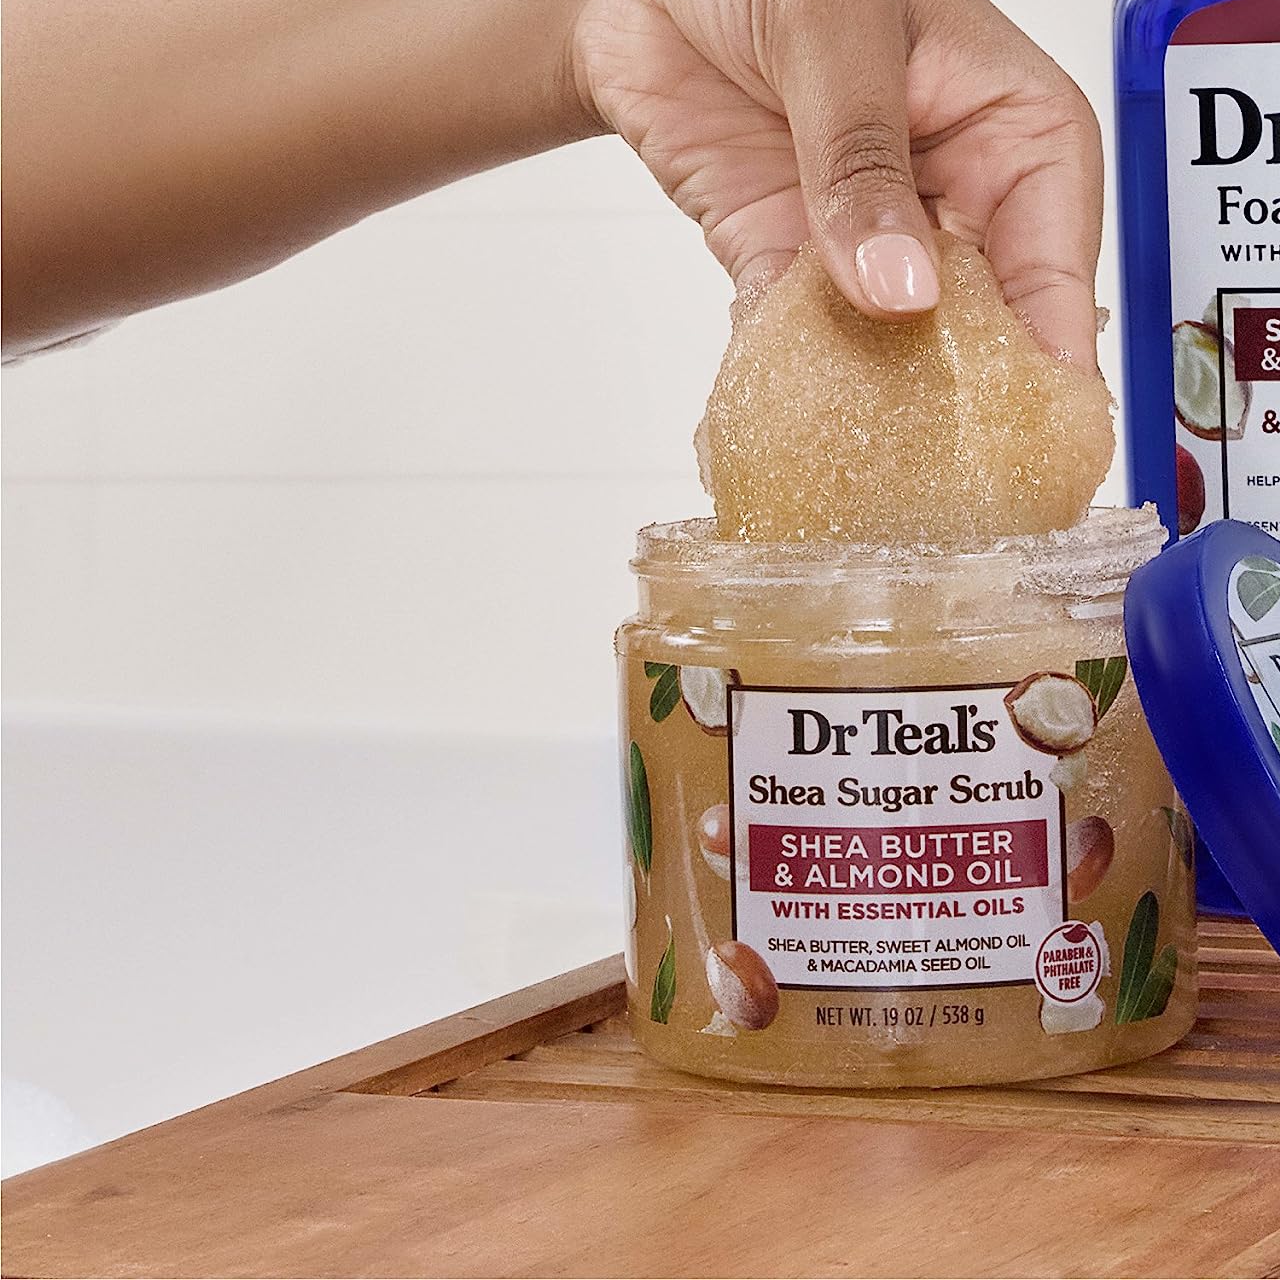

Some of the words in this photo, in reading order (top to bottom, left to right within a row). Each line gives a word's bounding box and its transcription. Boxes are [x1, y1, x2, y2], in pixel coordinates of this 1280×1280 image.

[788, 708, 858, 756] Dr
[748, 774, 826, 806] Shea
[836, 777, 939, 813] Sugar
[949, 770, 1044, 804] Scrub
[780, 833, 869, 859] SHEA
[881, 830, 1014, 859] BUTTER
[774, 863, 794, 888] &
[804, 862, 955, 889] ALMOND
[966, 859, 1023, 886] OIL
[771, 900, 829, 920] WITH
[837, 899, 967, 920] ESSENTIAL
[973, 896, 1025, 917] OILS
[768, 937, 807, 953] SHEA
[809, 939, 873, 956] BUTTER,
[876, 939, 932, 954] SWEET
[934, 935, 1004, 953] ALMOND
[1006, 933, 1031, 949] OIL
[1043, 946, 1085, 964] PARABEN
[1085, 946, 1095, 959] &
[807, 959, 818, 973] &
[821, 958, 917, 974] MACADAMIA
[920, 957, 962, 972] SEED
[965, 955, 991, 970] OIL
[1043, 959, 1095, 978] PHTHALATE
[1058, 975, 1081, 991] FREE
[816, 1006, 844, 1027] NET
[849, 1006, 878, 1028] WT.
[882, 1006, 898, 1027] 19
[904, 1006, 925, 1027] OZ
[929, 1004, 938, 1029] /
[942, 1004, 970, 1025] 538
[974, 1006, 985, 1026] g
